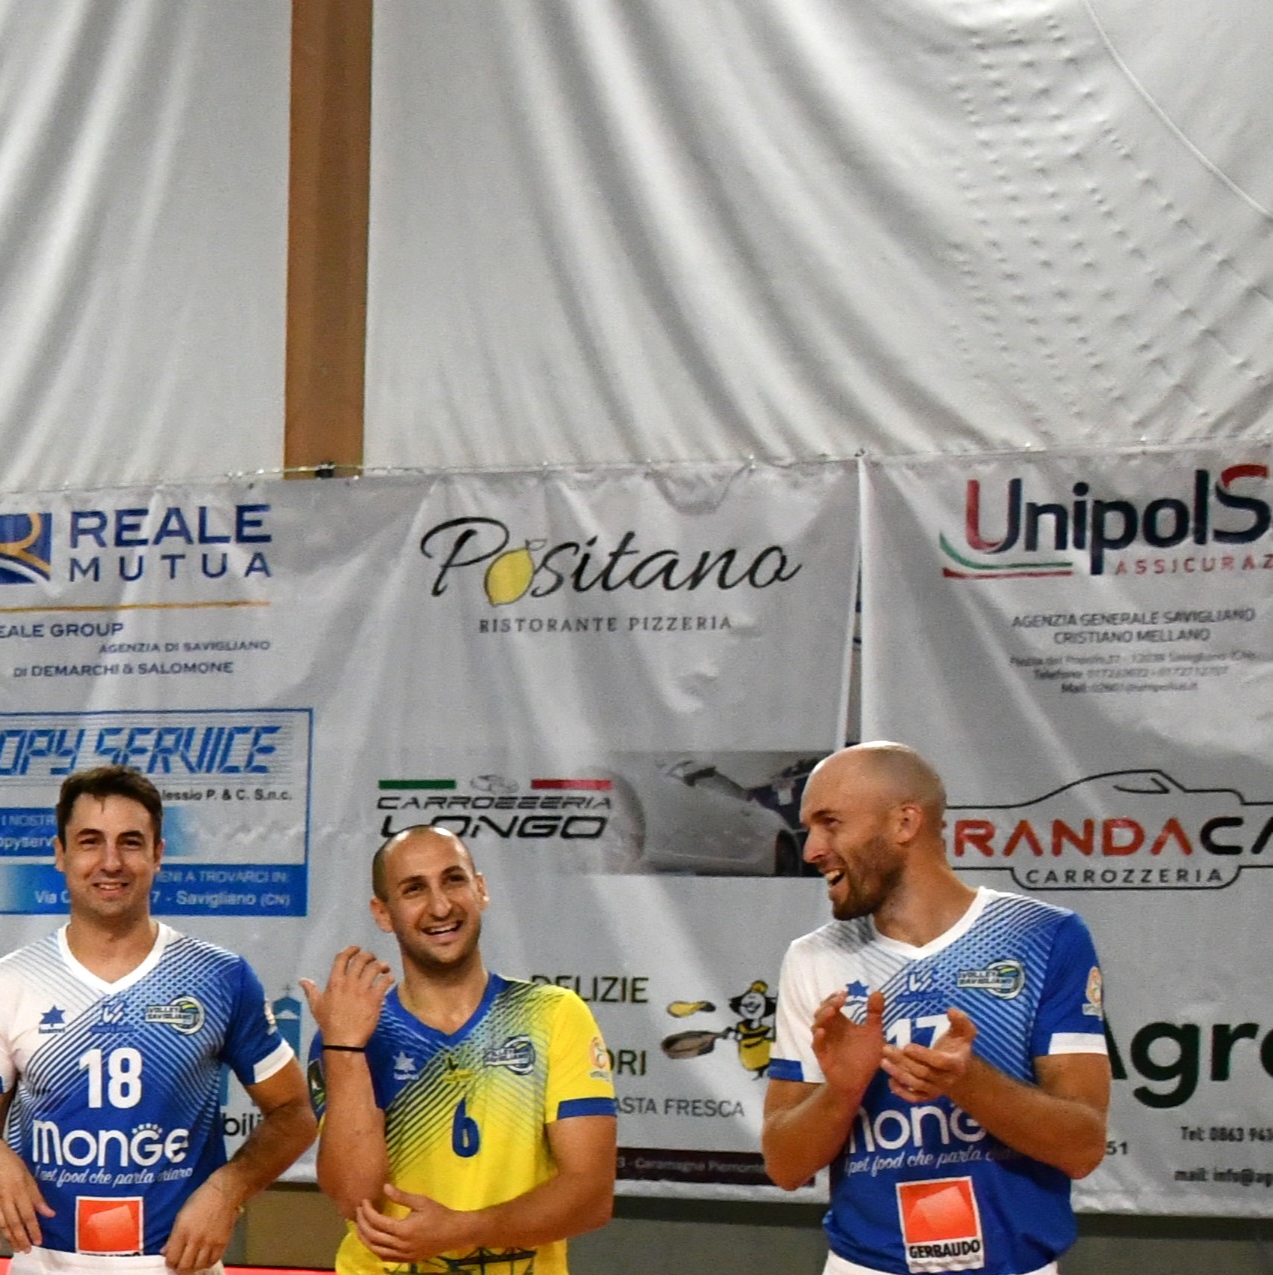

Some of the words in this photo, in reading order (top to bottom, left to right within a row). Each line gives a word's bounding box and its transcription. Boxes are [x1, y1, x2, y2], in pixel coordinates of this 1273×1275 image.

[69, 504, 272, 549] REALE
[965, 464, 1273, 576] UnipolS
[69, 551, 272, 583] MUTUA
[49, 621, 124, 637] GROUP
[478, 616, 617, 634] RISTORANTE
[629, 615, 732, 632] PIZZERIA
[1012, 612, 1076, 627] AGENZIA
[1080, 610, 1158, 625] GENERALE
[165, 641, 179, 652] DI
[1054, 630, 1133, 644] CRISTIANO
[1136, 628, 1210, 642] MELLANO
[13, 666, 27, 678] DI
[31, 662, 119, 677] DEMARCHI
[138, 660, 234, 675] SALOMONE
[95, 725, 282, 774] SERVICE
[222, 788, 232, 801] &
[381, 815, 609, 839] LONGO
[1026, 868, 1222, 883] CARROZZERIA
[35, 890, 58, 904] Via
[176, 890, 255, 908] Savigliano
[886, 1013, 949, 1049] 17
[79, 1047, 142, 1109] 18
[665, 1097, 744, 1118] FRESCA
[452, 1097, 480, 1158] 6
[873, 1151, 904, 1177] food
[907, 1149, 933, 1166] che
[936, 1145, 981, 1168] parla
[57, 1167, 86, 1188] food
[88, 1167, 110, 1183] che
[113, 1166, 154, 1188] parla
[909, 1239, 980, 1259] GERBAUDO
